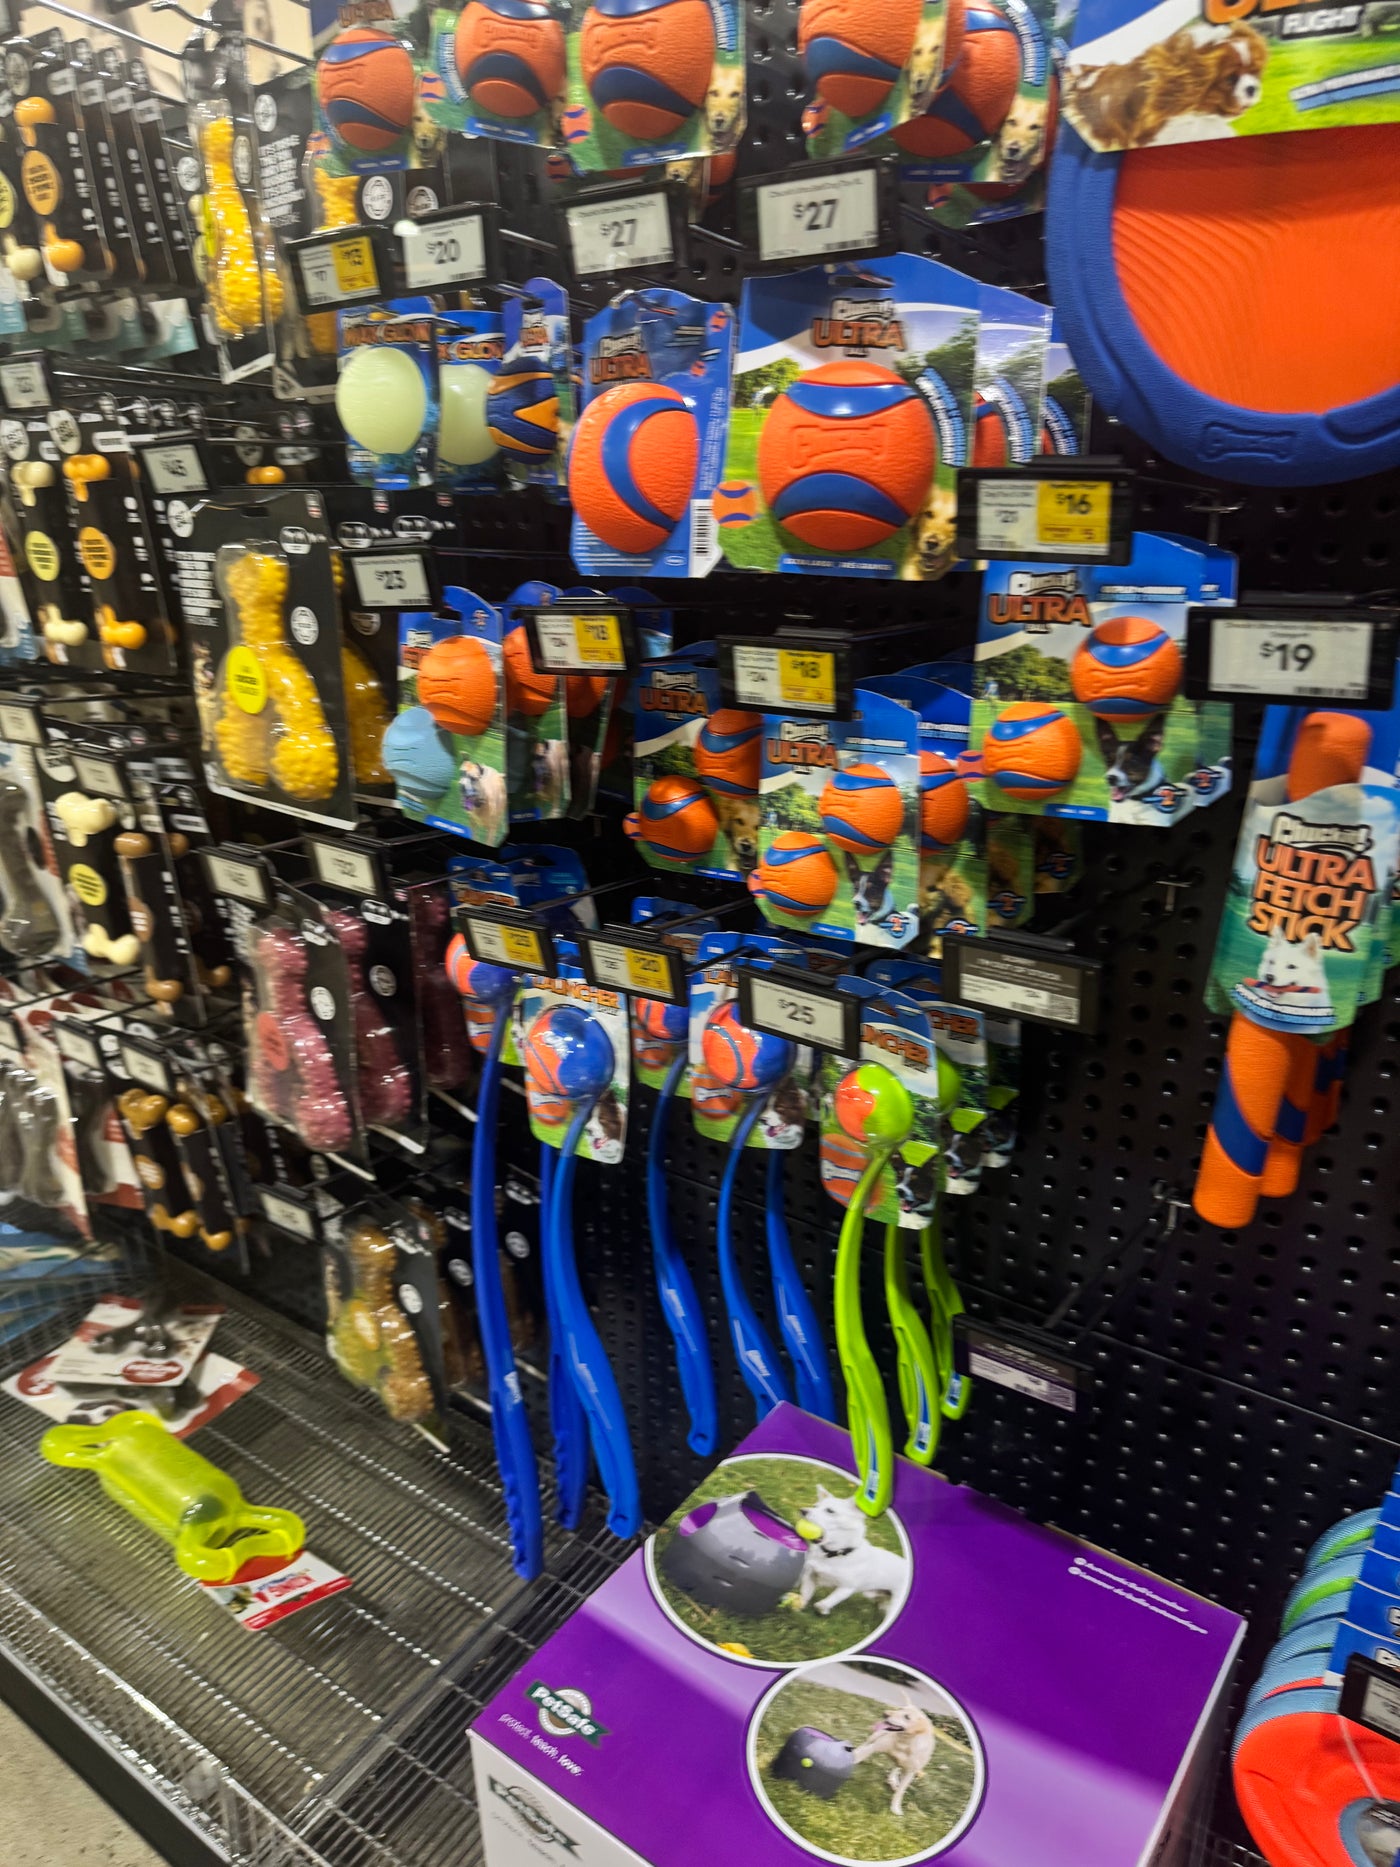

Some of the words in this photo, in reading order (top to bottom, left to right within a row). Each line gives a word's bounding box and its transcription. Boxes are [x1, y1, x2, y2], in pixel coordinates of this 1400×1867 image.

[1284, 7, 1362, 34] FLIGHT
[793, 199, 839, 231] $27
[601, 218, 638, 248] $27
[426, 238, 461, 265] $20
[813, 317, 906, 350] ULTRA
[589, 351, 652, 384] ULTRA
[1055, 493, 1092, 516] $16
[988, 593, 1092, 627] ULTRA
[1260, 642, 1316, 672] $19
[640, 686, 708, 717] ULTRA
[766, 738, 839, 771] ULTRA
[1256, 834, 1375, 892] ULTRA
[1254, 869, 1368, 922] FETCH
[1248, 900, 1357, 952] STICK
[778, 999, 816, 1025] $25
[531, 1686, 597, 1736] PetSafe
